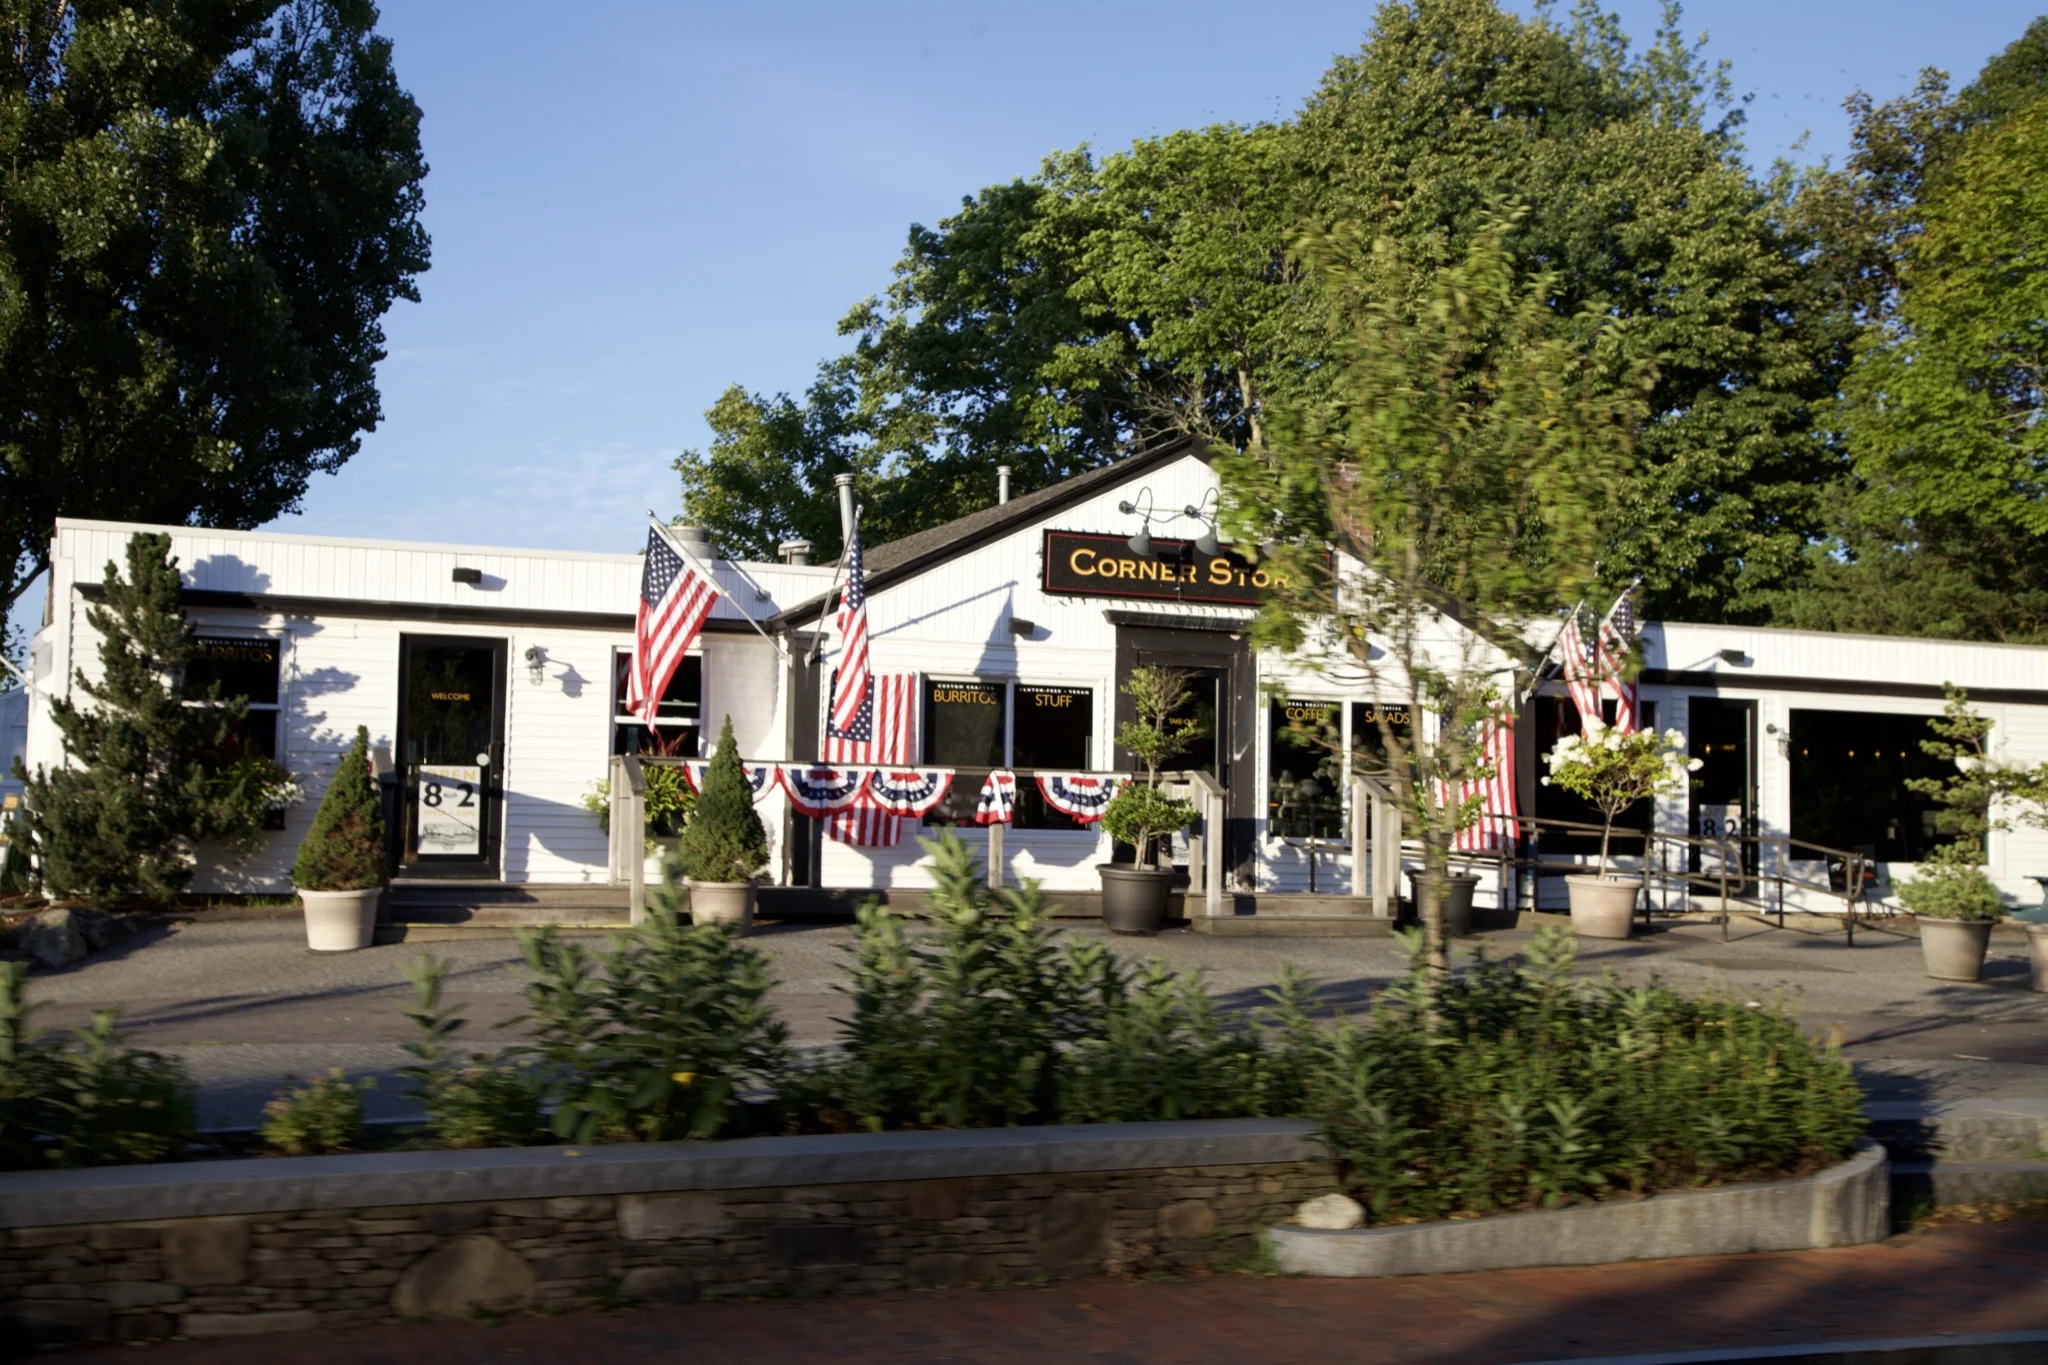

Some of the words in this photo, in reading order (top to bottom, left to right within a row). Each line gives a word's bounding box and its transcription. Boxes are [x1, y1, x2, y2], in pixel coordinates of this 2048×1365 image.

[1069, 548, 1198, 584] CORNER
[1208, 557, 1292, 589] STOR
[431, 692, 471, 701] WELCOME
[933, 689, 997, 705] BURRITOS
[1035, 693, 1073, 708] STUFF
[426, 768, 476, 781] OPEN
